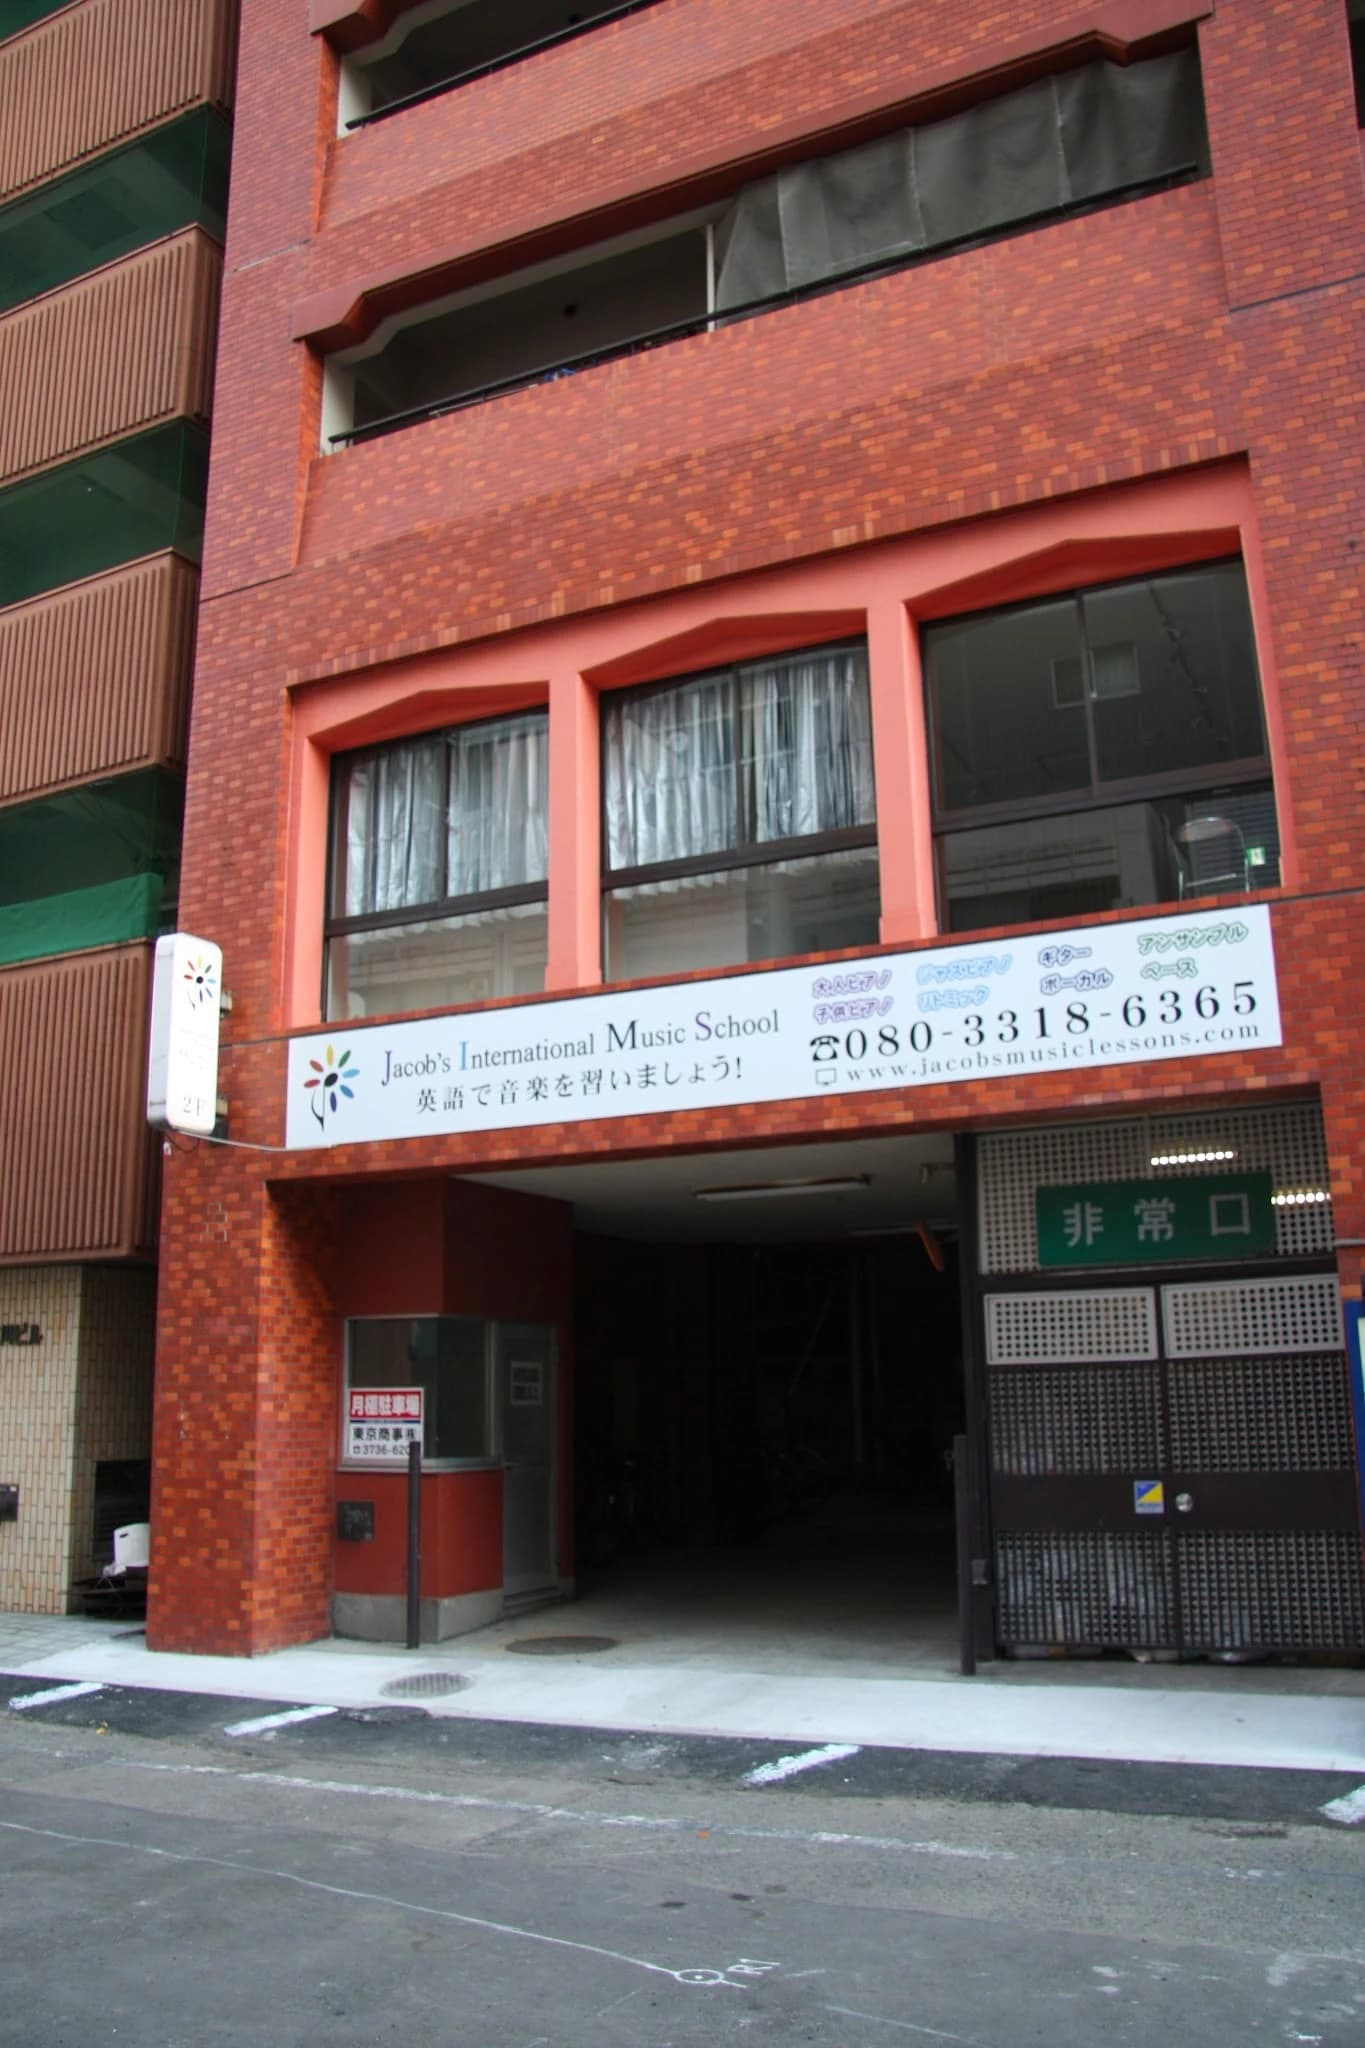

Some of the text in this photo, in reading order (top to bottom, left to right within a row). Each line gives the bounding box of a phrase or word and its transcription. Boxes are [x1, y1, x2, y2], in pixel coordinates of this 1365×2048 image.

[1137, 921, 1249, 954] アンサンブル
[1038, 945, 1092, 967] ギター
[1140, 957, 1199, 980] ベース
[1040, 967, 1114, 996] ボーカル
[813, 996, 895, 1024] 子供ピアノ
[845, 980, 1258, 1062] 080-3318-6365
[381, 1009, 780, 1087] Jacob's International Music School
[847, 1023, 1261, 1082] www.jacobsmusiclessons.com
[417, 1055, 743, 1114] 英語で音楽を習いましょう!
[183, 1095, 208, 1117] 2F
[1063, 1193, 1251, 1247] 非常口
